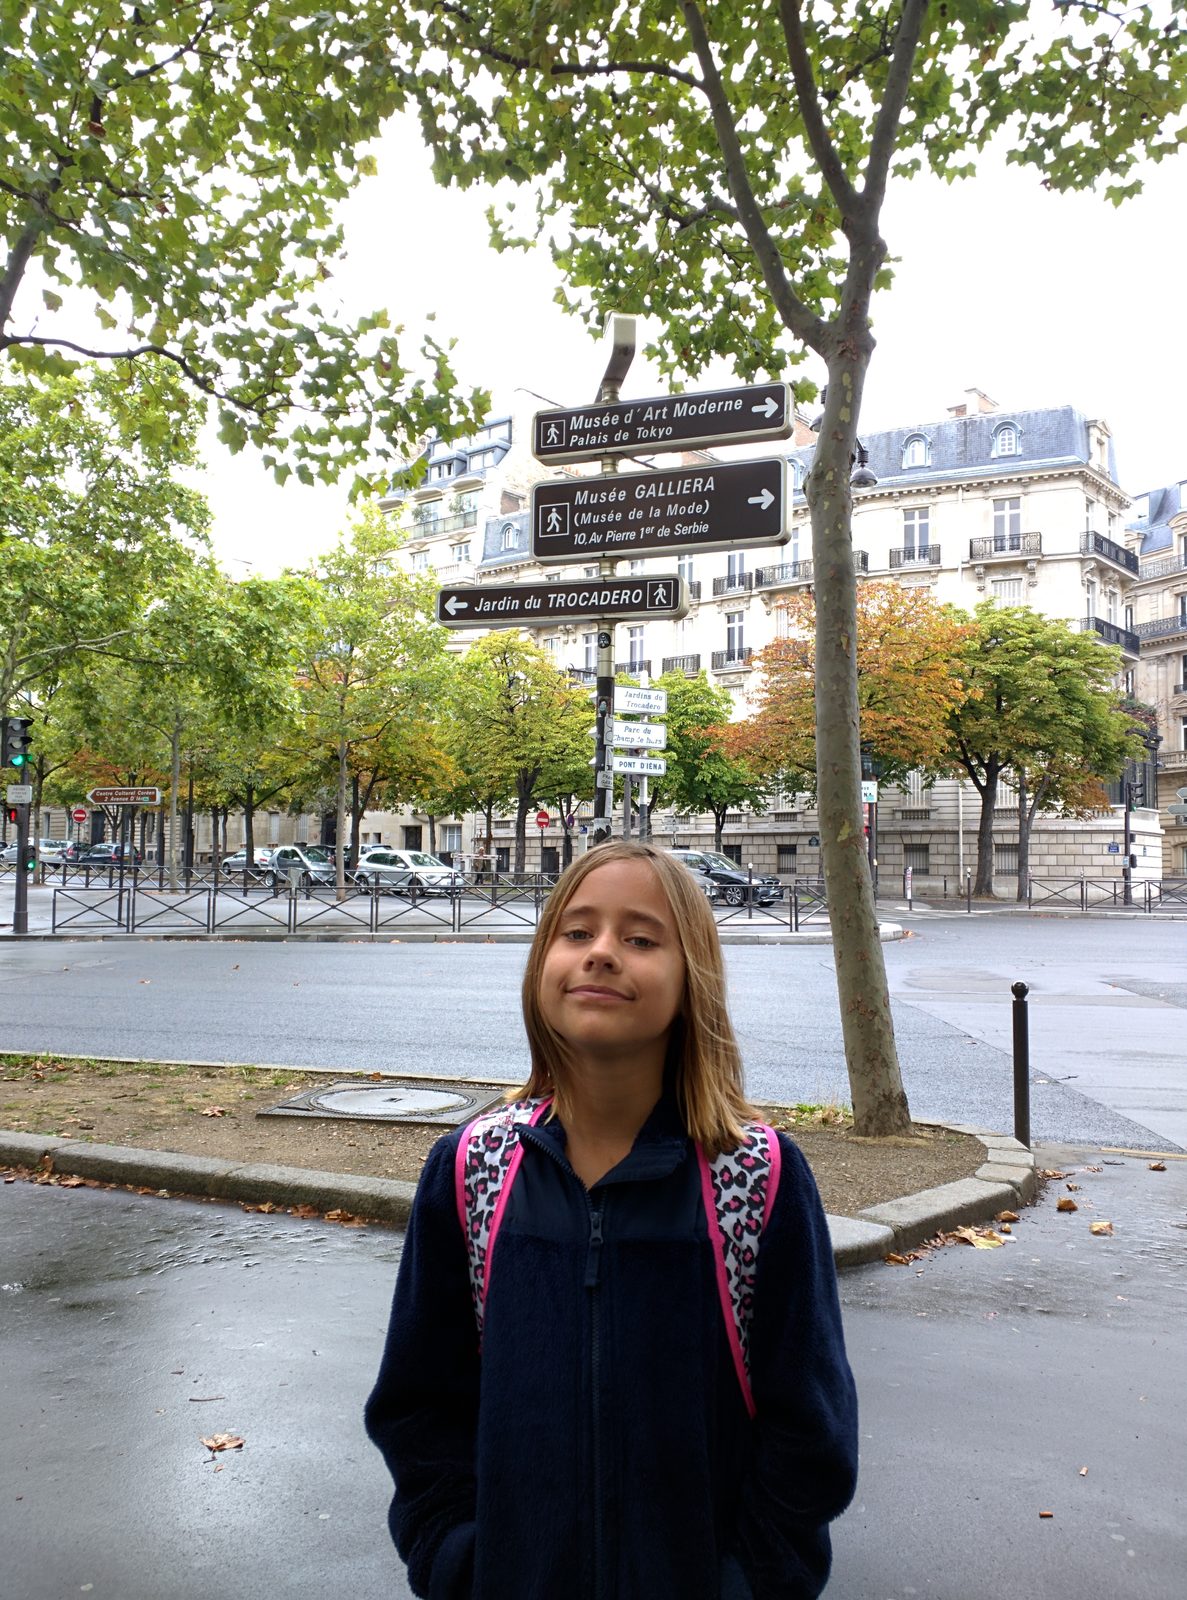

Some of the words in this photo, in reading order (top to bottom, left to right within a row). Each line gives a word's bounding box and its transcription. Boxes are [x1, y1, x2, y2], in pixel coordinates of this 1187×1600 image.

[569, 411, 619, 431] Musée
[673, 398, 743, 418] Moderne
[569, 432, 608, 447] Palais
[614, 429, 629, 442] de
[636, 425, 673, 439] Tokyo
[574, 488, 626, 506] Musée
[635, 476, 715, 499] GALLIERA
[574, 510, 622, 527] (Musée
[628, 507, 643, 520] de
[649, 505, 660, 518] la
[666, 499, 710, 517] Mode)
[605, 528, 636, 542] Pierre
[639, 525, 655, 540] 1er
[657, 524, 670, 537] de
[674, 522, 709, 536] Serbie
[474, 596, 519, 612] Jardin
[524, 596, 542, 610] du
[548, 589, 643, 608] TROCADERO
[624, 691, 652, 700] Jardins
[618, 760, 636, 769] PONT
